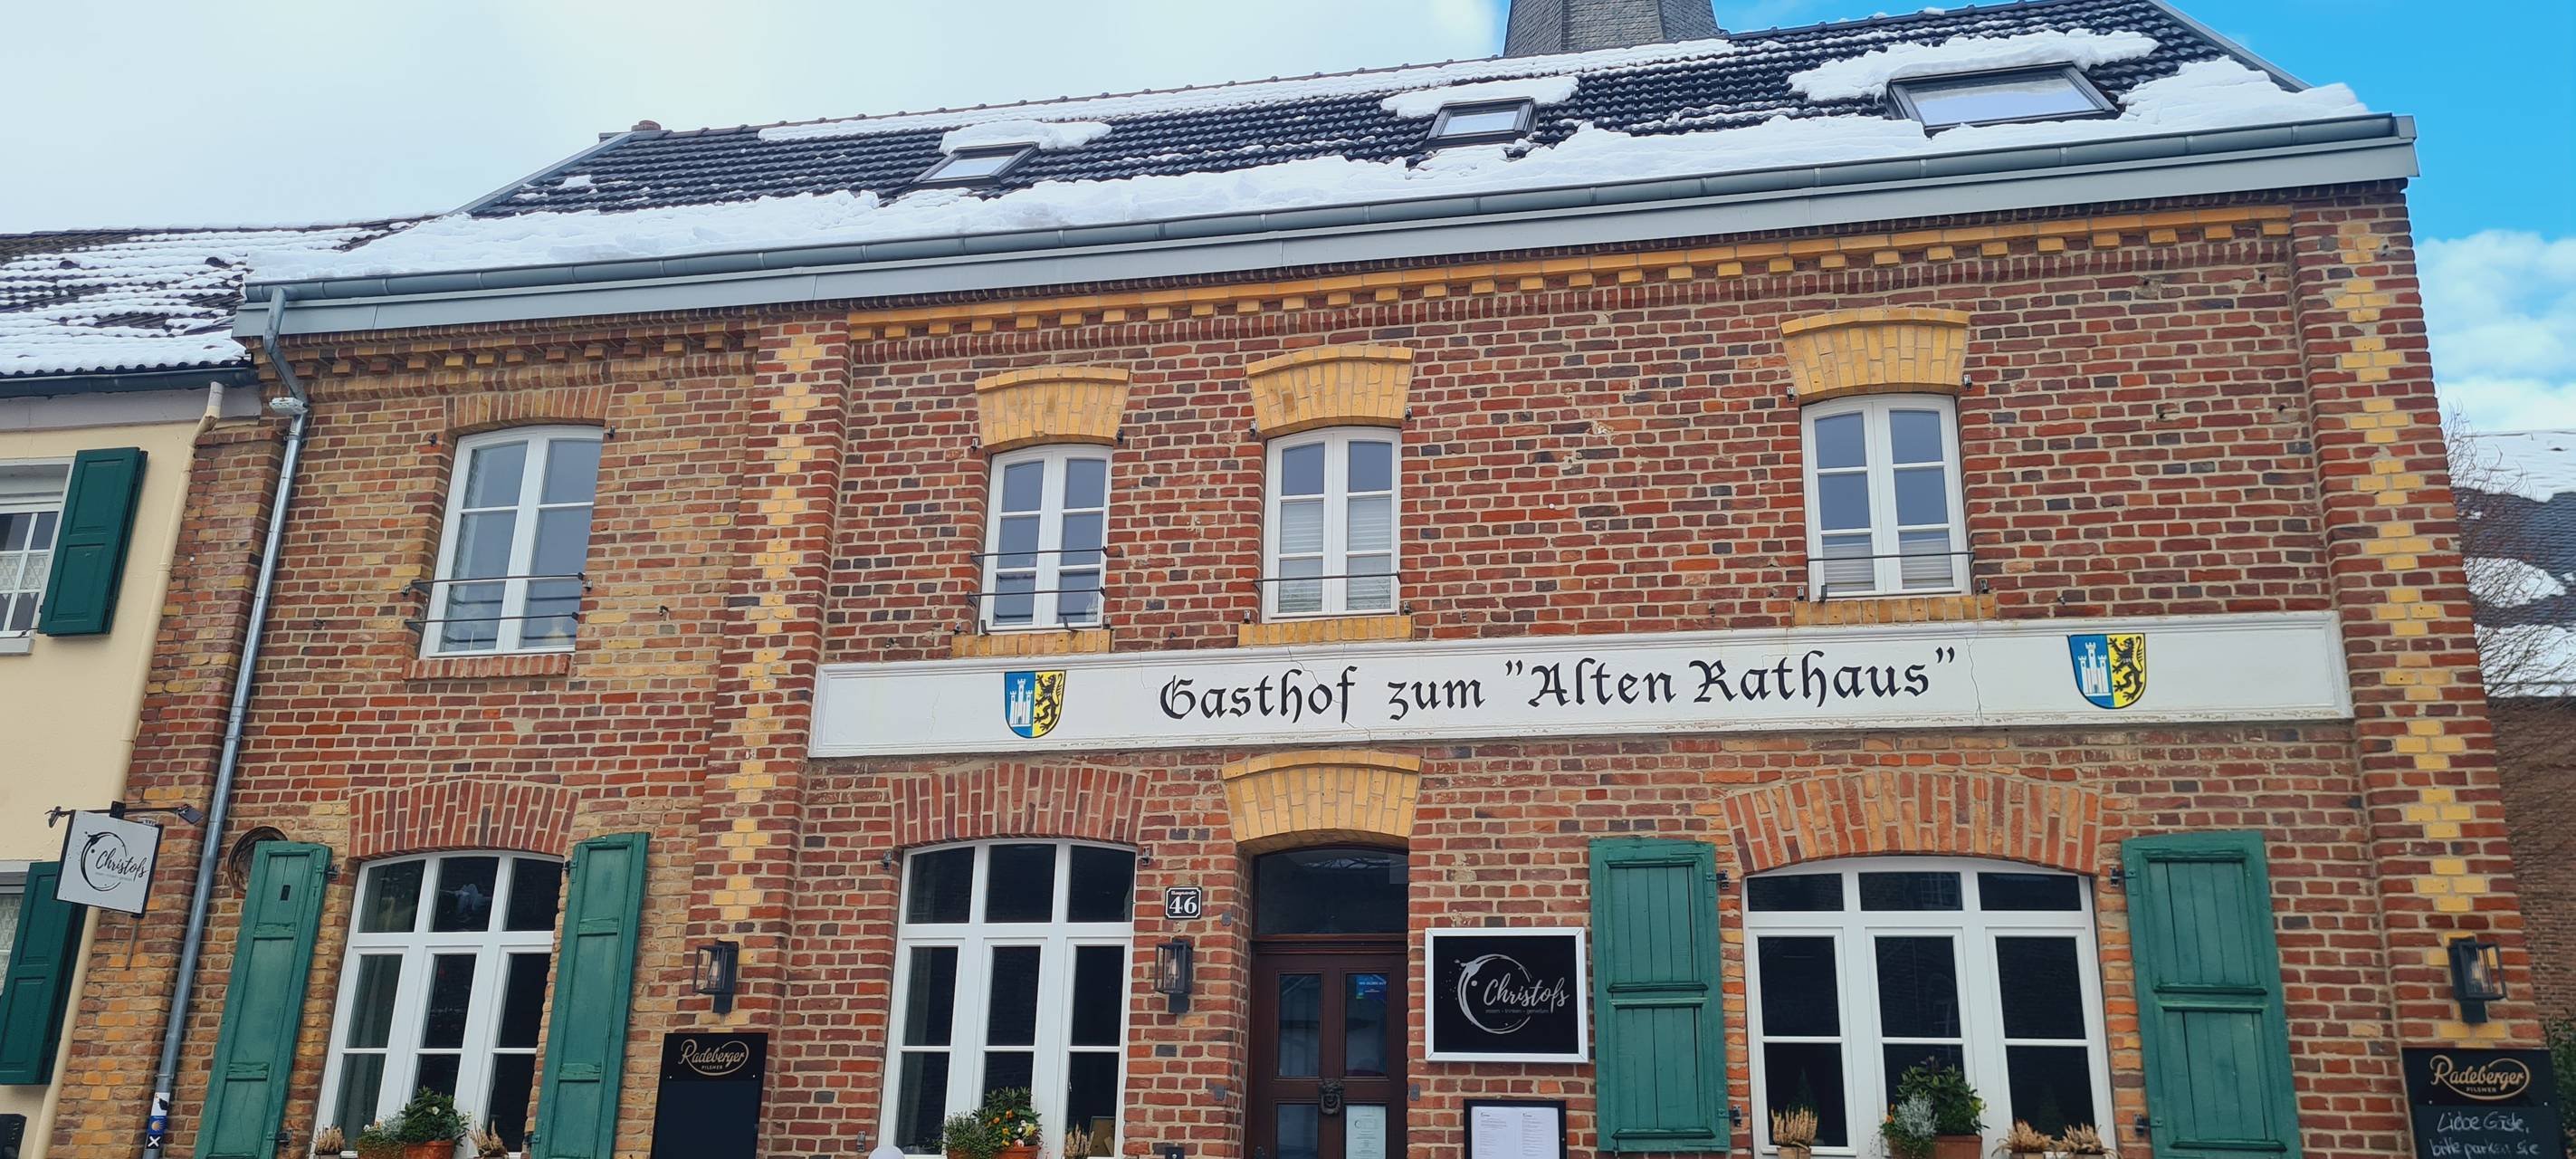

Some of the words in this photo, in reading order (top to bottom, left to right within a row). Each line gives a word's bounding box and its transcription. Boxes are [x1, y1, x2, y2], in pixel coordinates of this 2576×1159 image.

[1159, 666, 1359, 724] Gasthof
[1386, 676, 1486, 723] zum
[95, 848, 148, 883] Christofs
[1169, 896, 1197, 915] 46
[1483, 972, 1570, 1013] Christofs
[678, 1039, 749, 1070] Radeberger
[2429, 1054, 2528, 1092] Radeberger
[2437, 1110, 2482, 1133] Liebe
